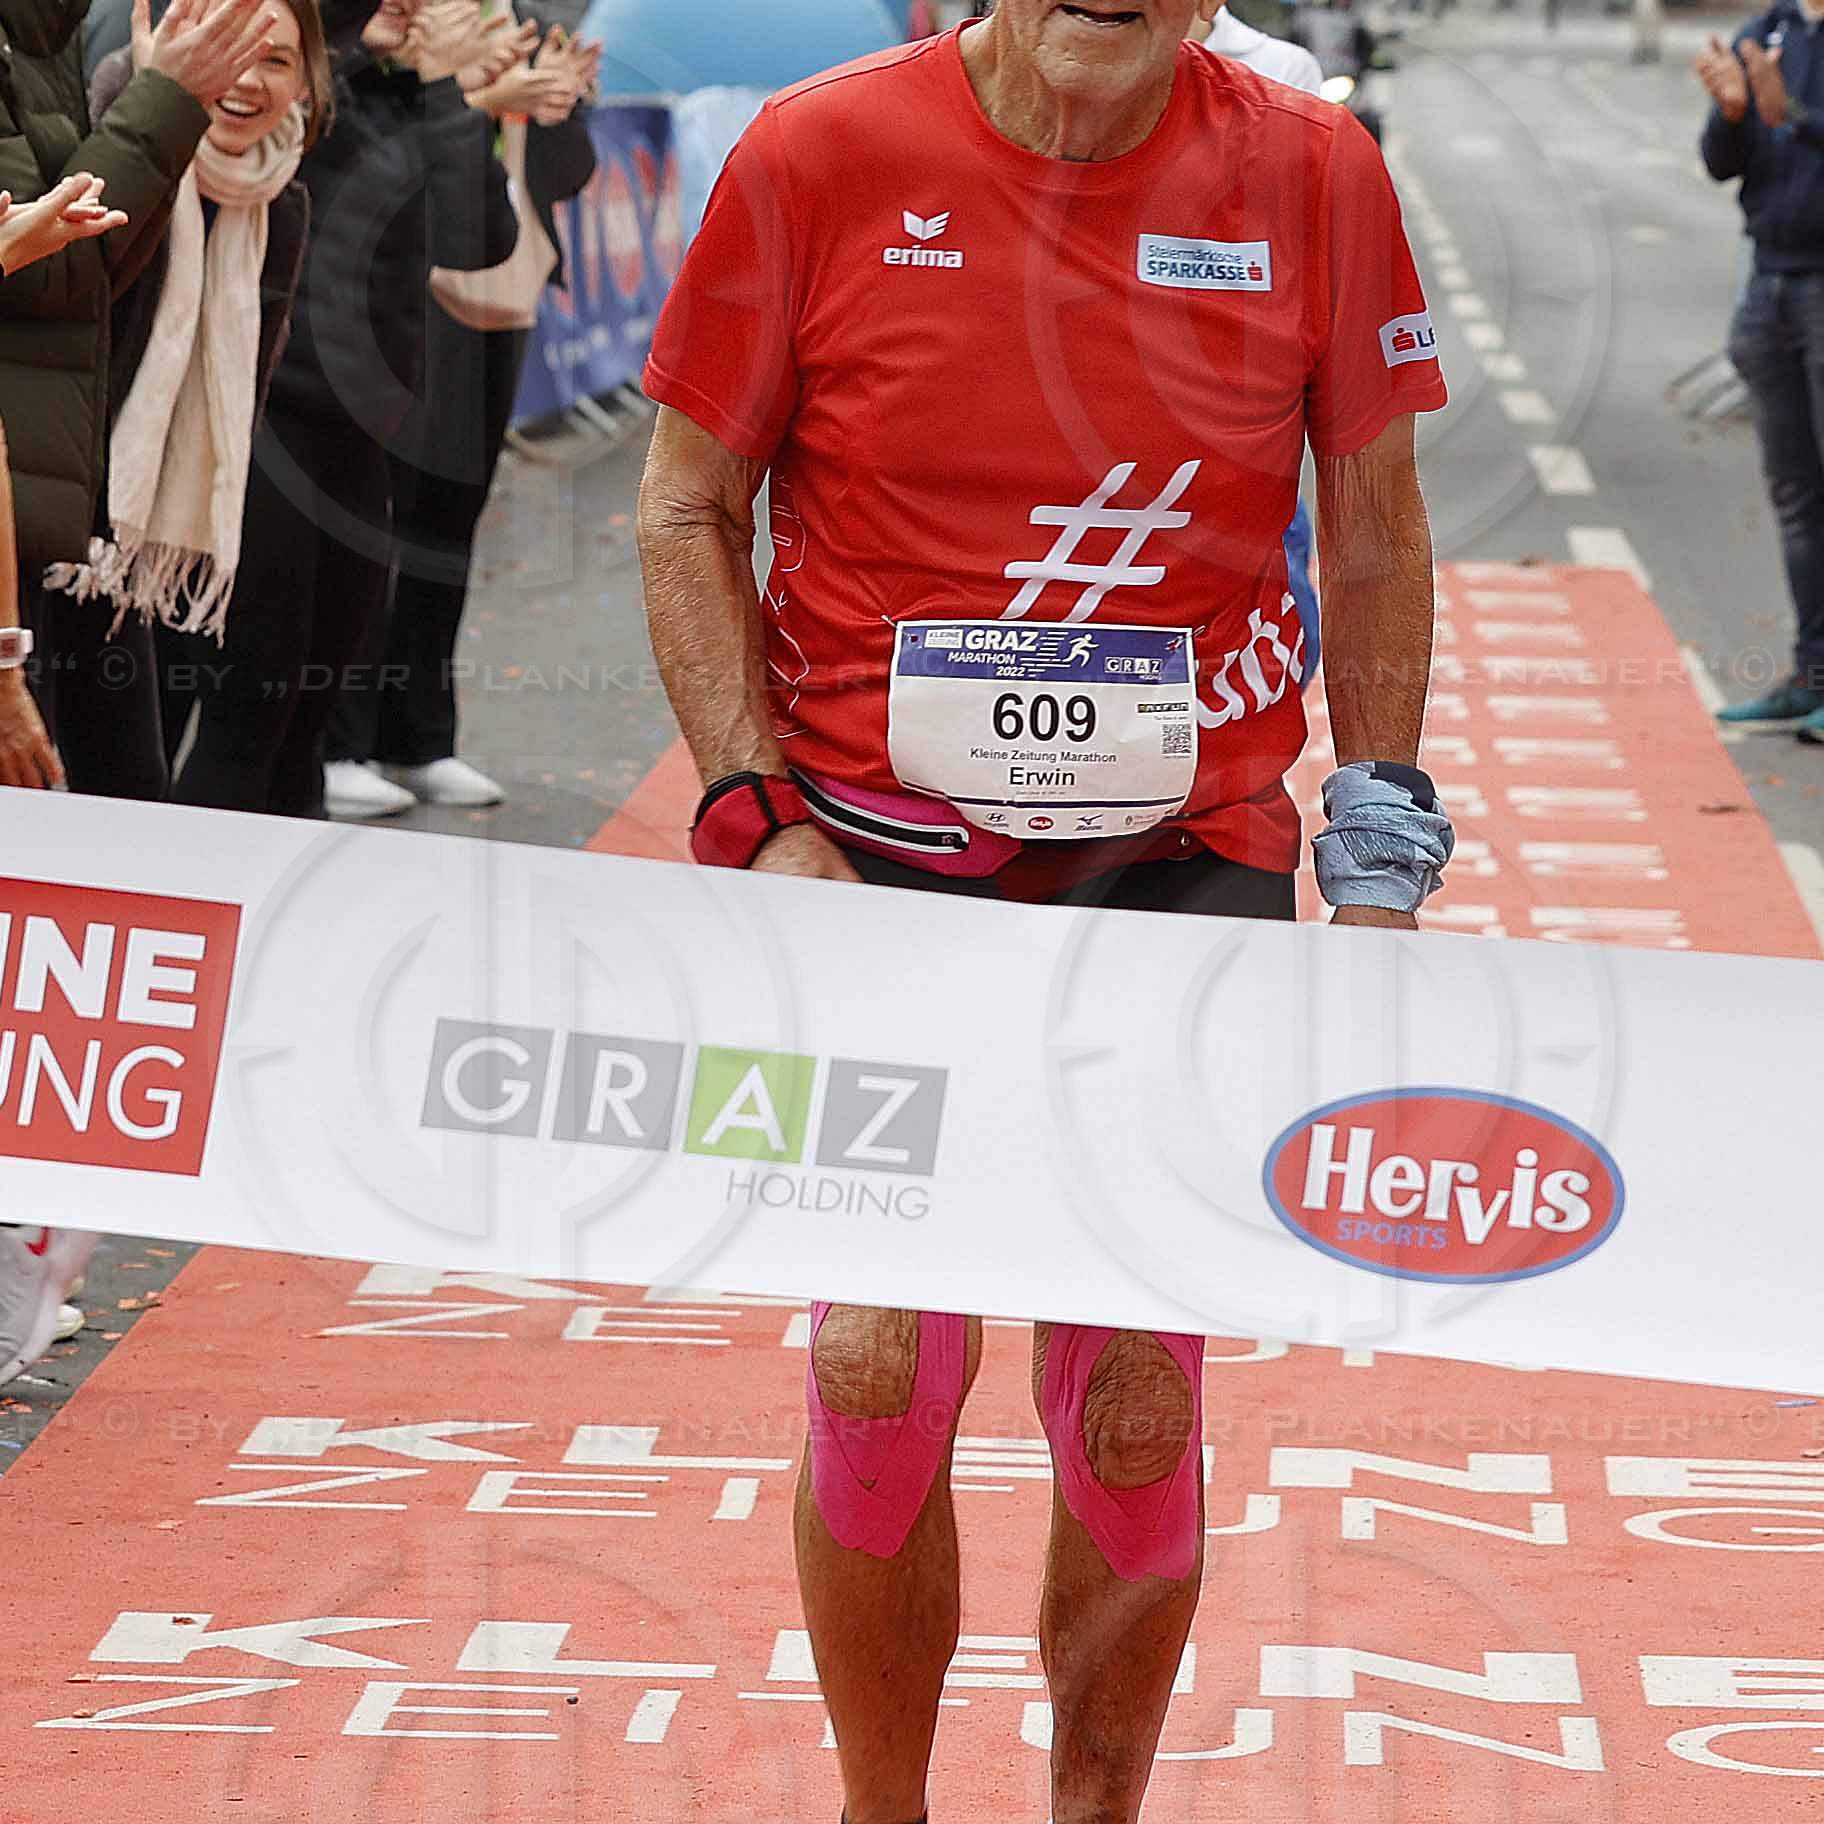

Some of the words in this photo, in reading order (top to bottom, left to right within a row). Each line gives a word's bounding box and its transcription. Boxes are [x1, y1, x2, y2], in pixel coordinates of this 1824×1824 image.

[882, 244, 964, 269] erima
[1147, 243, 1244, 264] Steiermärkische
[1147, 262, 1246, 281] SPARKASSE
[964, 629, 1039, 652] GRAZ
[947, 652, 1017, 665] MARATHON
[1107, 658, 1162, 674] GRAZ
[995, 665, 1026, 677] 2022
[992, 691, 1098, 743] 609
[970, 746, 1008, 761] Kleine
[1011, 749, 1058, 764] Zeitung
[1060, 751, 1117, 764] Marathon
[1009, 766, 1076, 787] Erwin
[440, 1033, 922, 1166] GRAZ
[725, 1167, 932, 1223] HOLDING
[1300, 1122, 1592, 1247] Hervis
[1335, 1215, 1449, 1253] SPORTS
